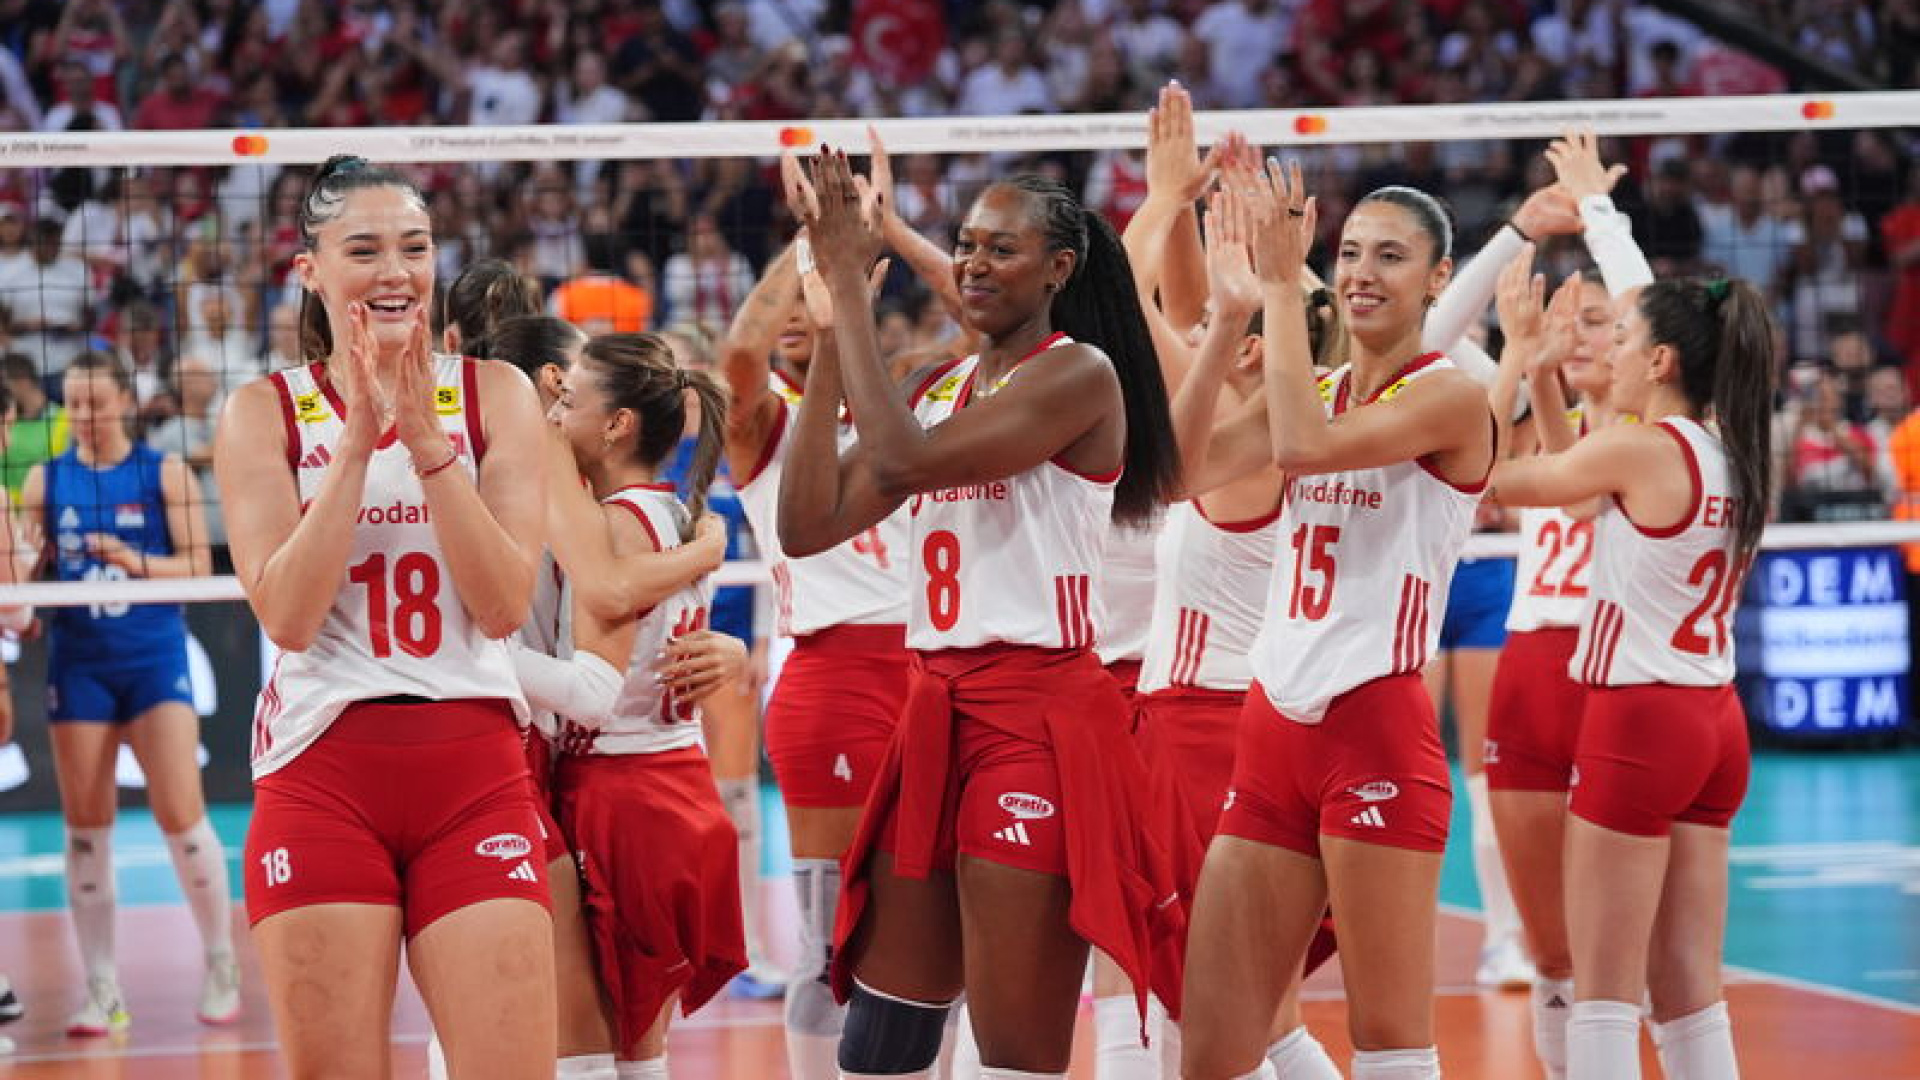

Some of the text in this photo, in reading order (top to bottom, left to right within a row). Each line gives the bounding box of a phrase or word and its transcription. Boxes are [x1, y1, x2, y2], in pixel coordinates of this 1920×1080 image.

[923, 530, 961, 632] 8
[1289, 523, 1340, 620] 15
[1528, 520, 1594, 597] 22
[350, 552, 443, 659] 18
[833, 753, 853, 783] 4
[261, 847, 291, 888] 18
